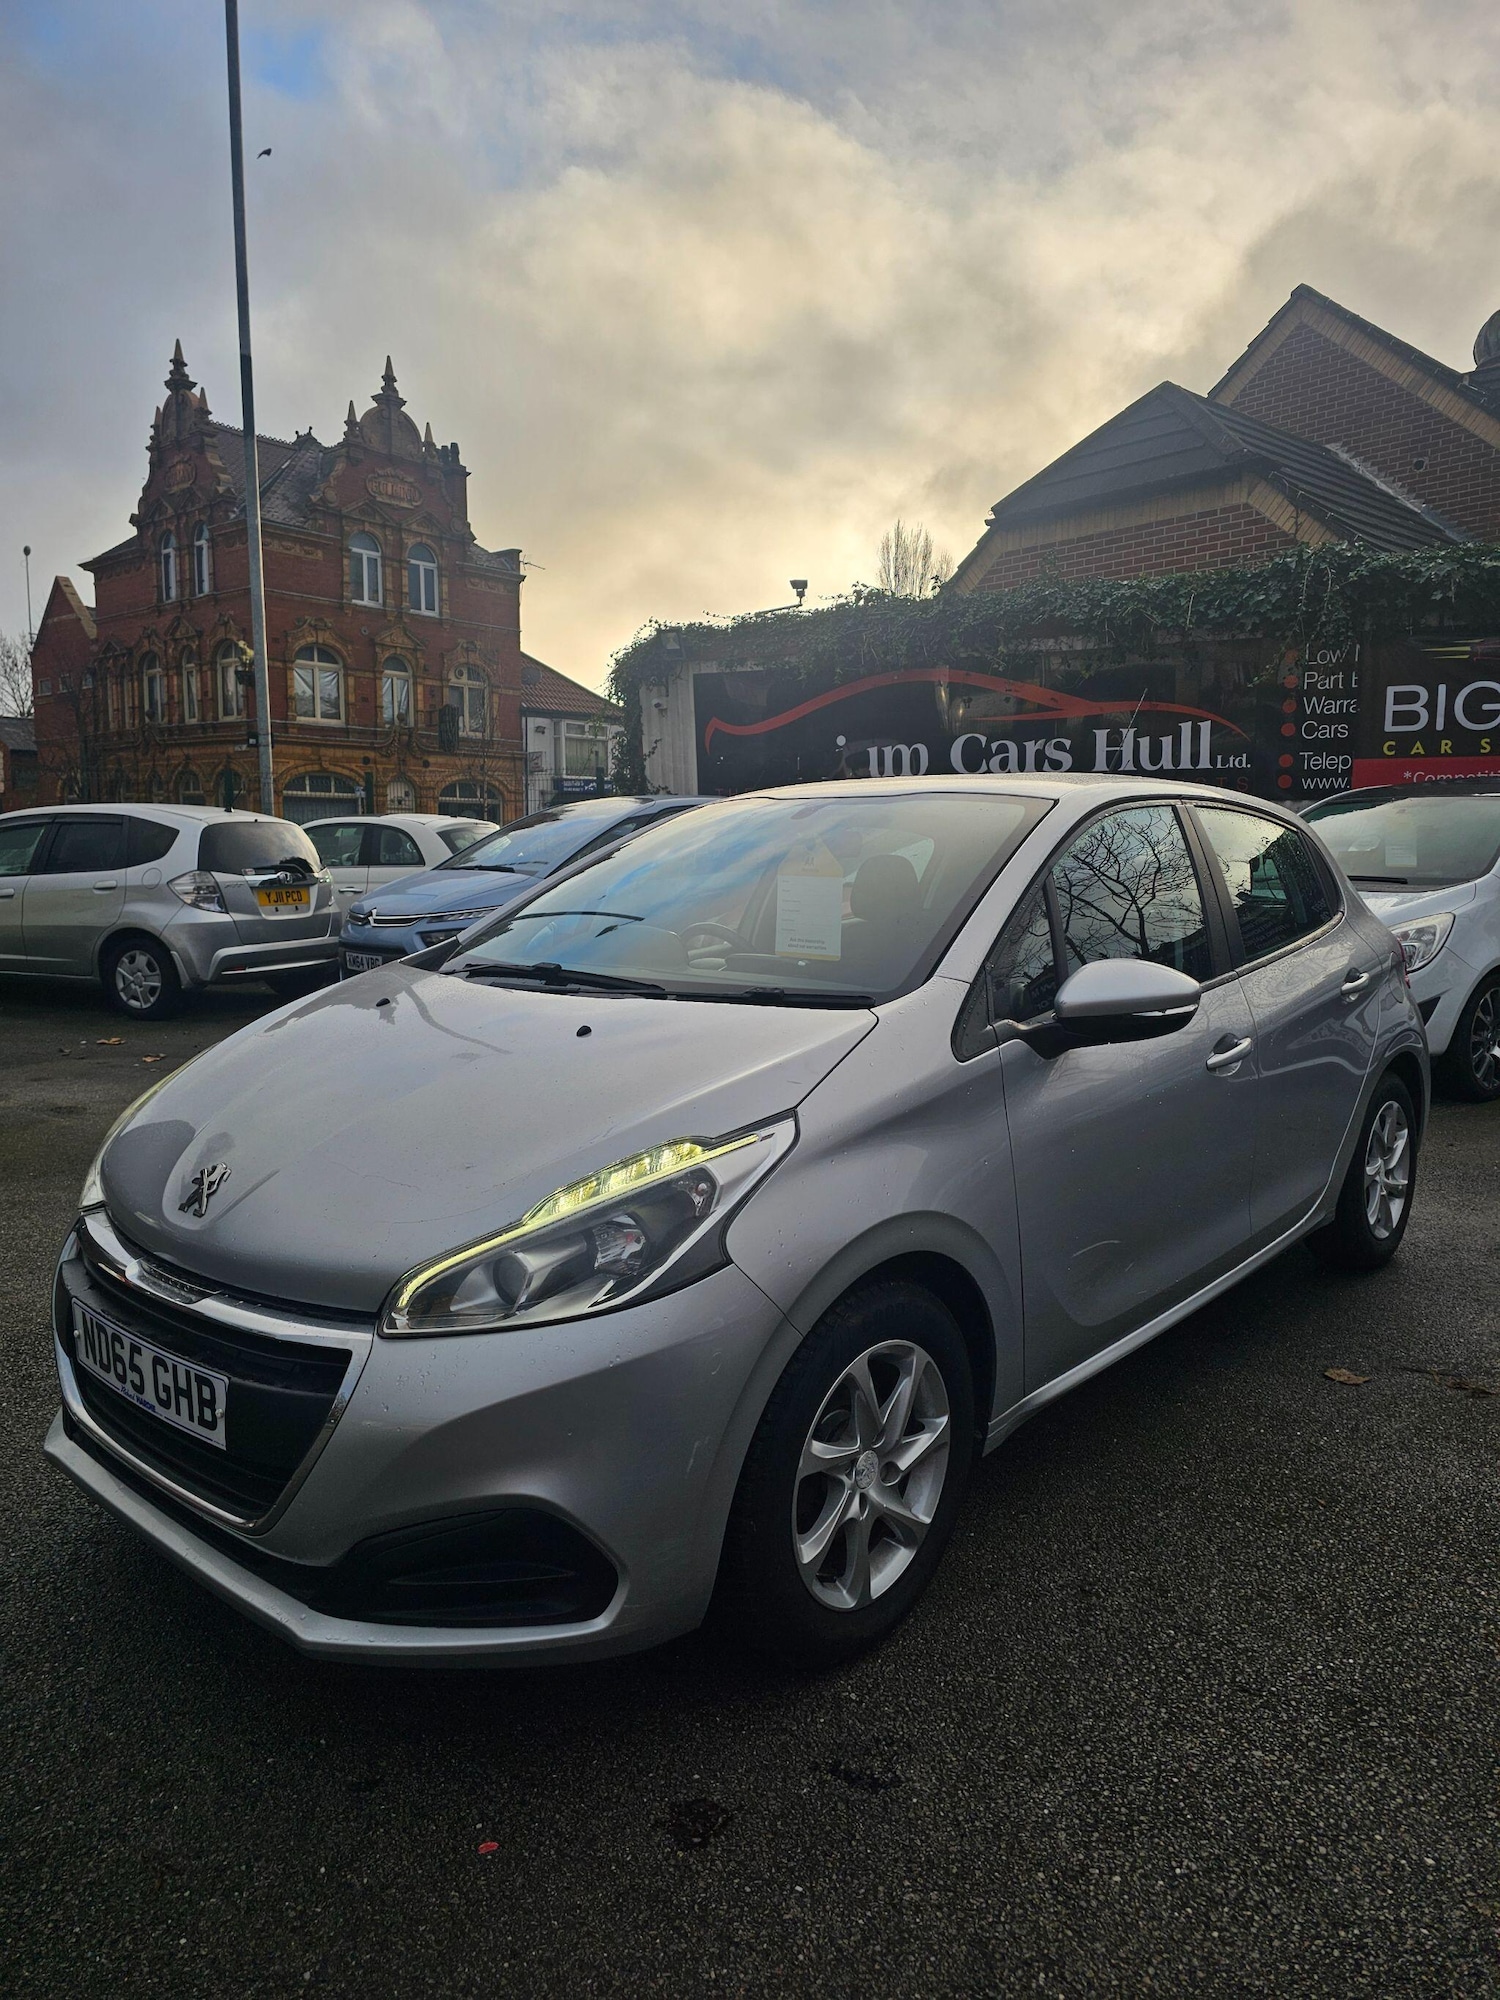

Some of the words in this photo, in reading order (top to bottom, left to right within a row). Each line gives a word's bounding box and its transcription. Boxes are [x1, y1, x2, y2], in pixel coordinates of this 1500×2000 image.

[1304, 643, 1347, 665] Low
[1303, 671, 1344, 690] Part
[1384, 681, 1500, 732] BIG
[1301, 720, 1349, 739] Cars
[950, 733, 1073, 774] Cars
[1092, 720, 1214, 771] Hull
[1216, 753, 1251, 769] Ltd.
[1299, 752, 1352, 773] Telep
[1302, 777, 1350, 789] www.
[286, 890, 303, 903] PCD
[81, 1310, 145, 1396] ND65
[152, 1355, 218, 1432] GHB
